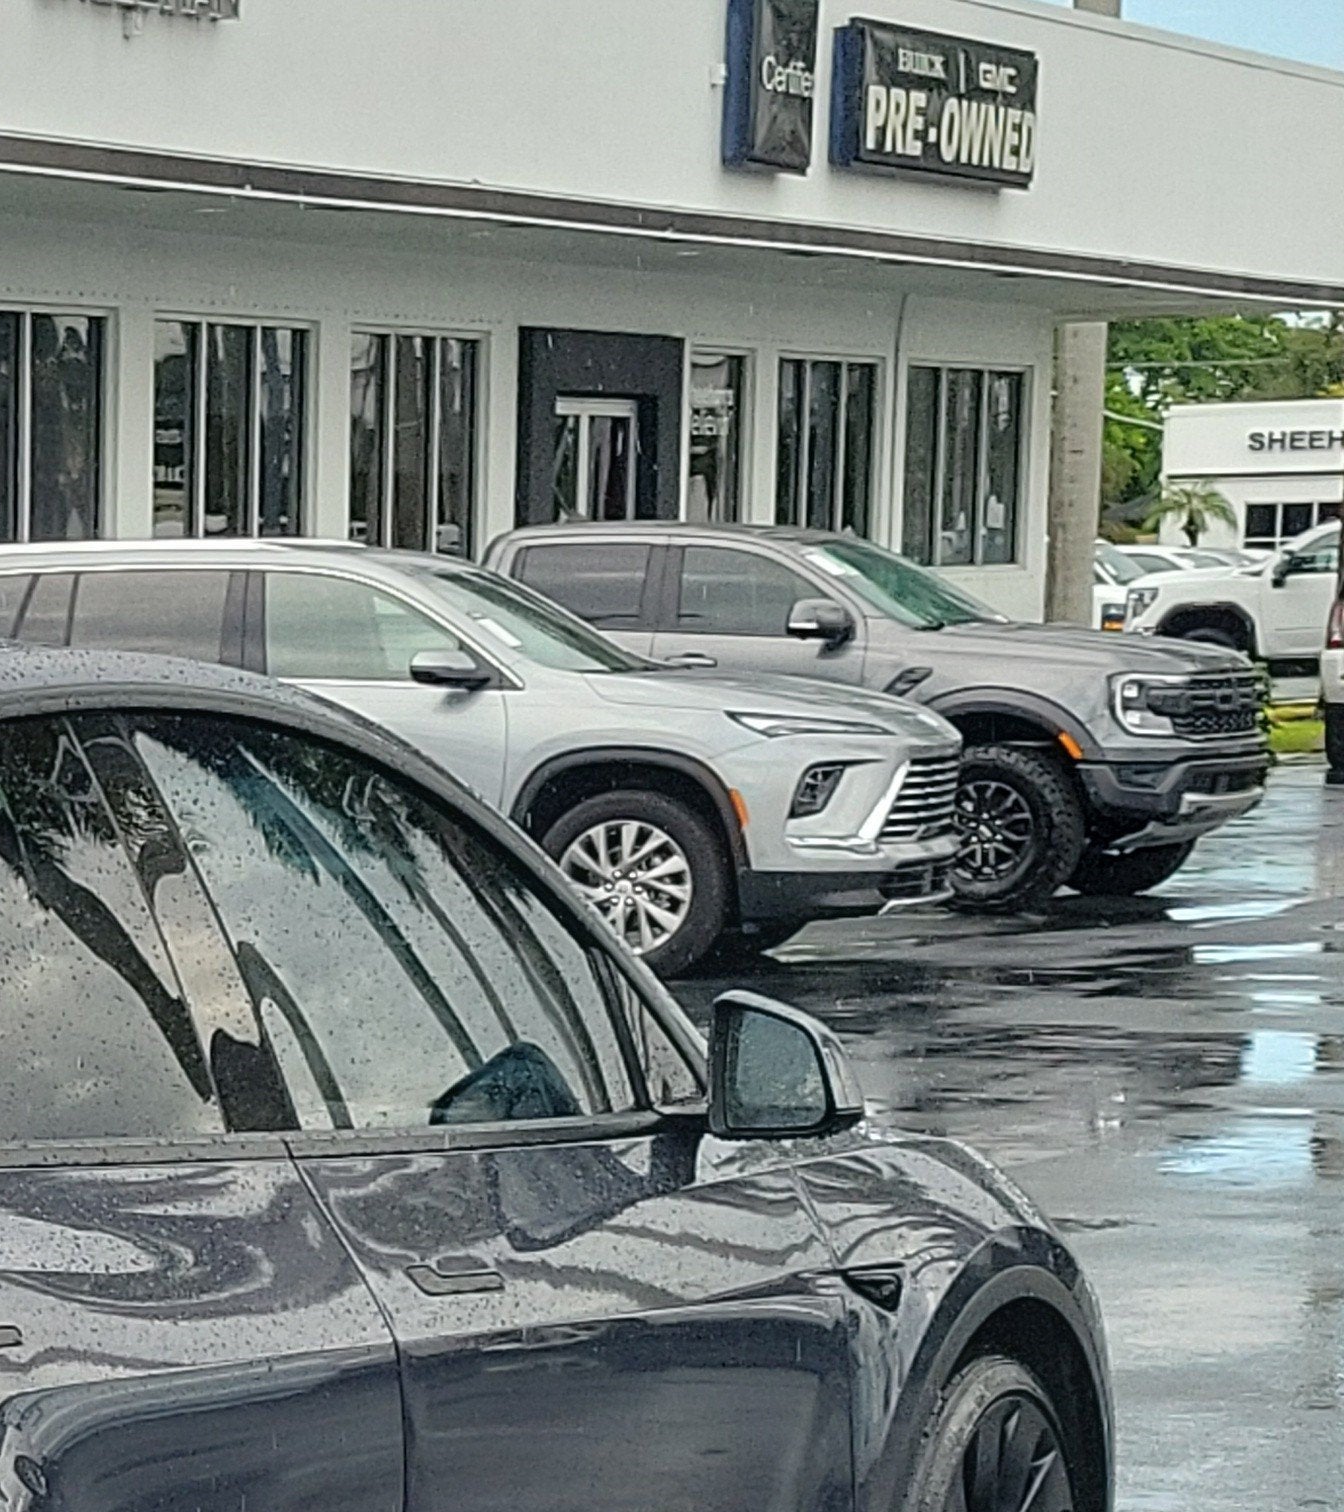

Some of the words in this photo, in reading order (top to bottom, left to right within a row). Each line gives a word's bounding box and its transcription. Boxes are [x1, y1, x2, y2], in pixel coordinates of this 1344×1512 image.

[897, 47, 947, 80] BUICK
[978, 62, 1019, 94] GMC
[865, 85, 1036, 173] PRE-OWNED
[1248, 430, 1344, 452] SHEEH
